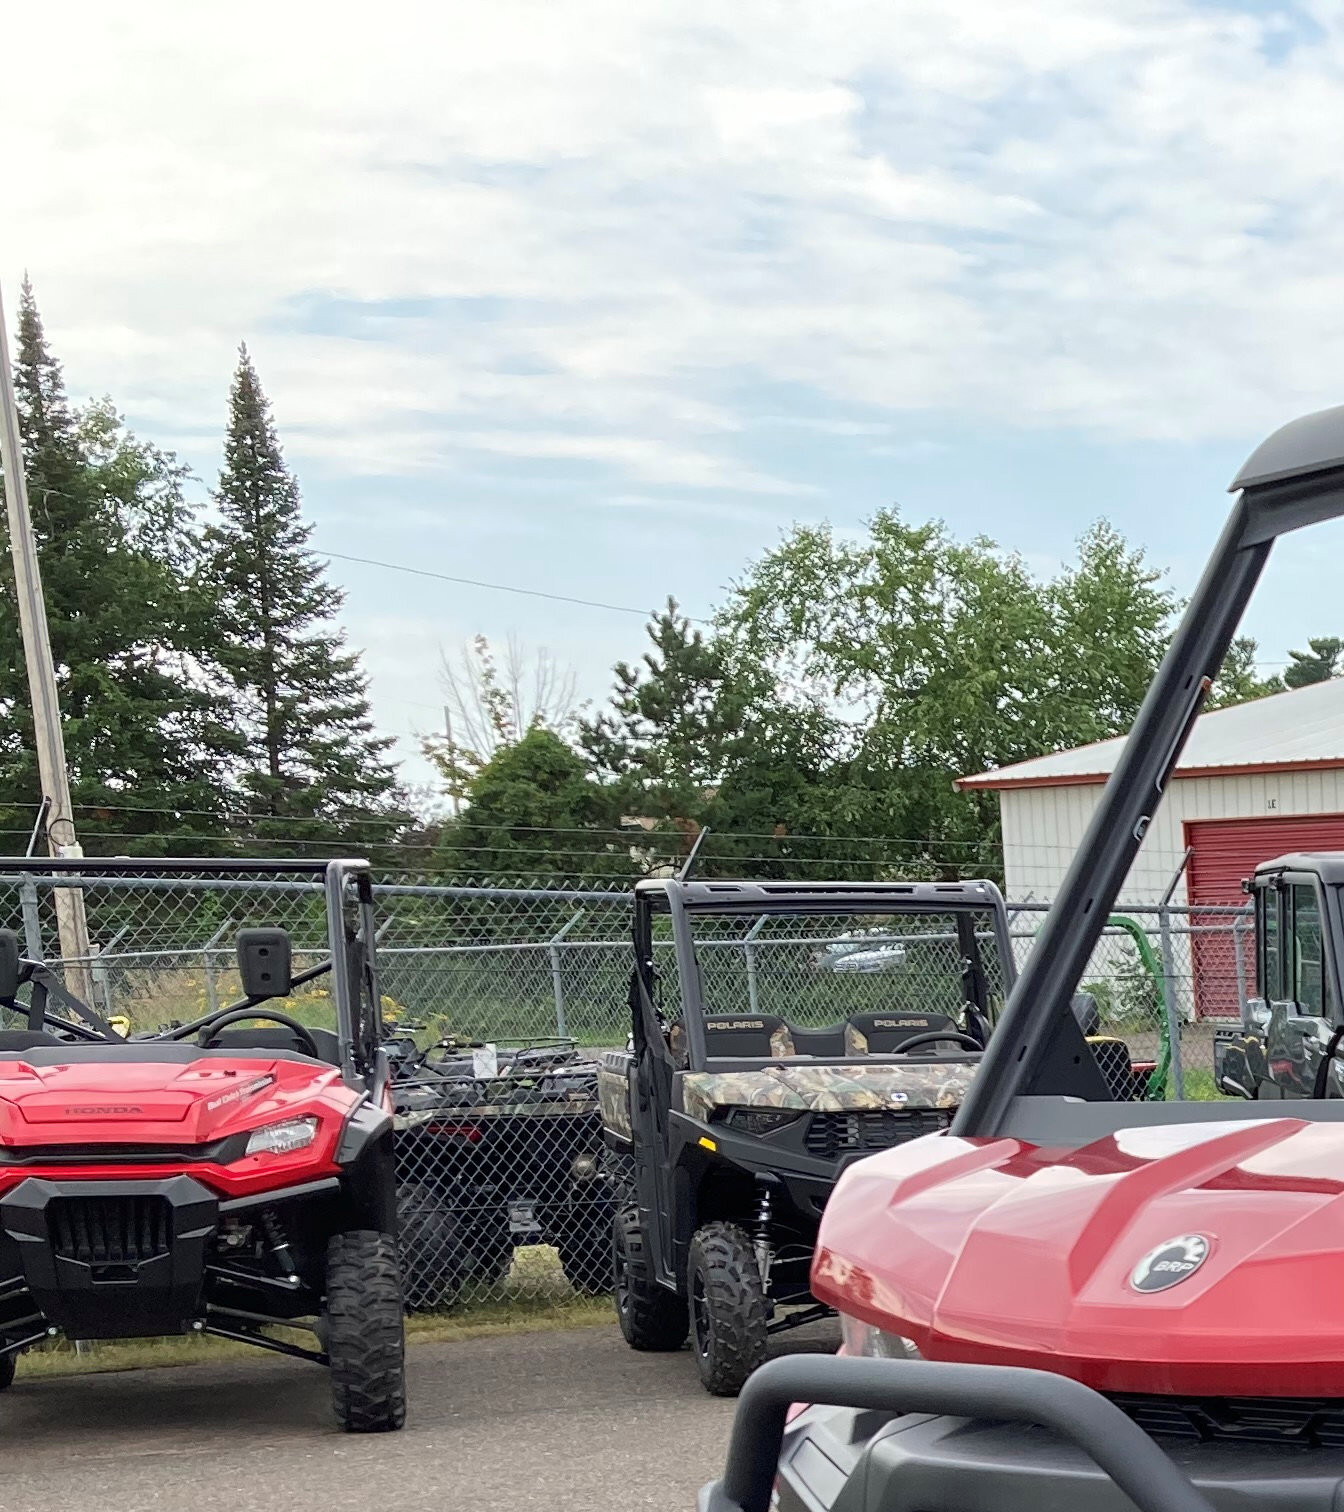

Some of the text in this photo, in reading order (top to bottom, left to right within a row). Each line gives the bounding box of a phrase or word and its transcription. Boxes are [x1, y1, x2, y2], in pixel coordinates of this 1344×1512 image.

[707, 1020, 764, 1030] POLARIS
[873, 1019, 928, 1027] POLARIS
[64, 1105, 144, 1115] HONDA
[1153, 1260, 1194, 1272] BRP
